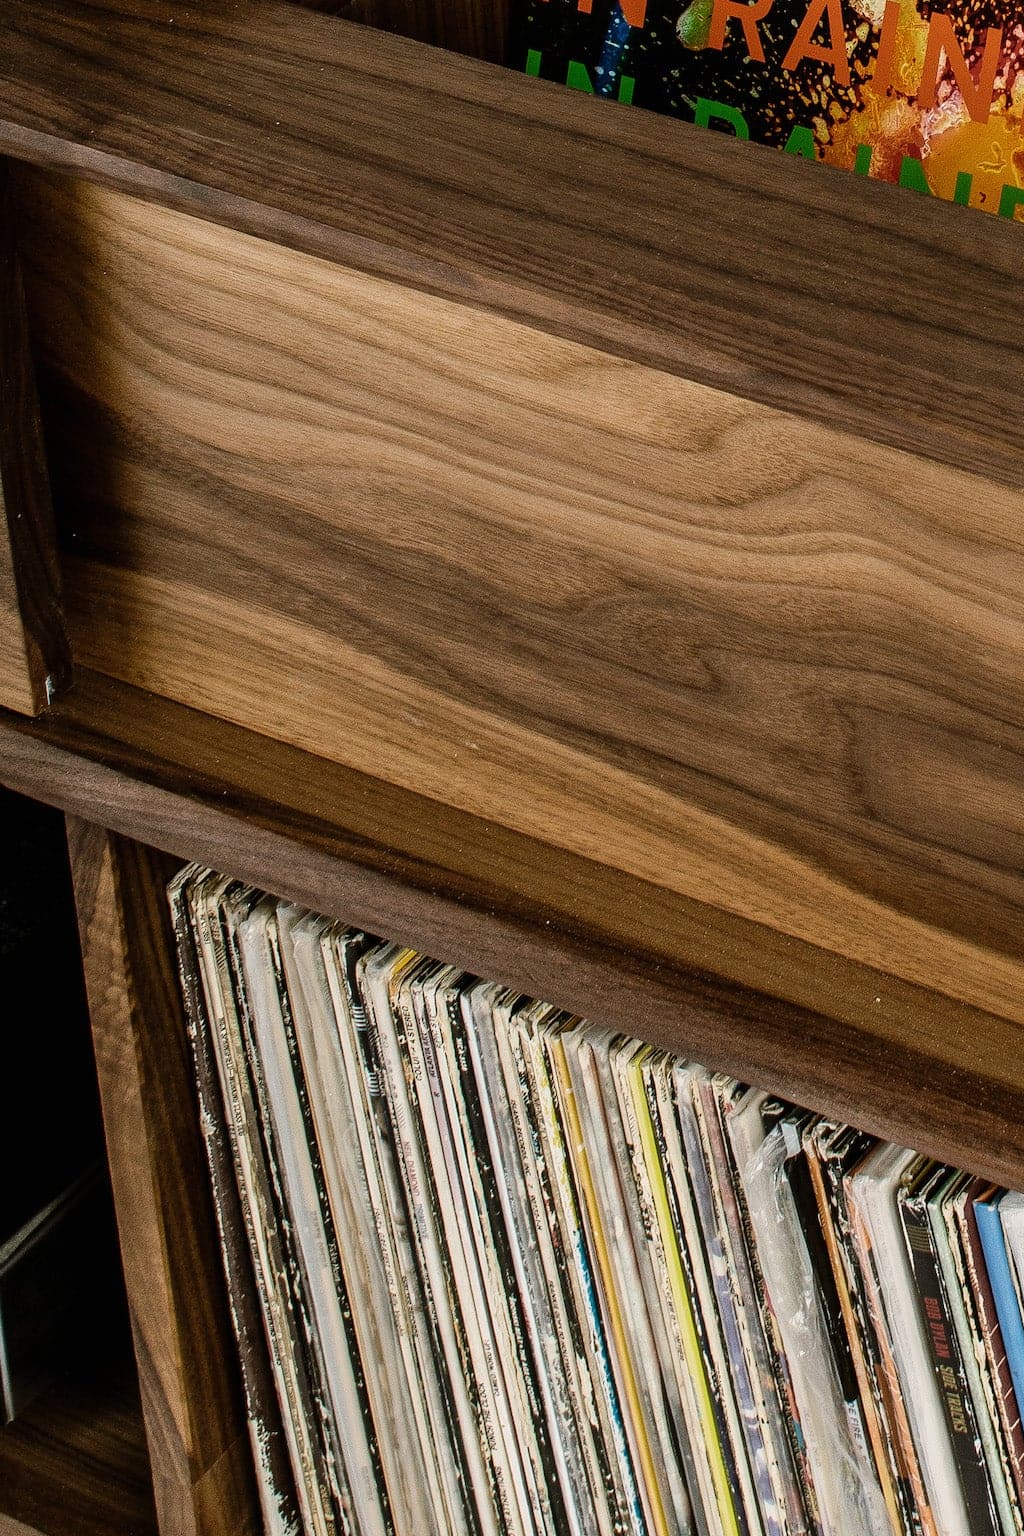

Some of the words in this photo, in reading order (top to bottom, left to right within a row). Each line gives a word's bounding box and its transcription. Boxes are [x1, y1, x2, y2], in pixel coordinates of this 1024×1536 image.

[404, 1158, 421, 1197] DIAMOND
[922, 1293, 942, 1322] BOB
[928, 1318, 951, 1360] DYLAN
[938, 1361, 958, 1391] SIDE
[944, 1388, 968, 1436] TRACKS
